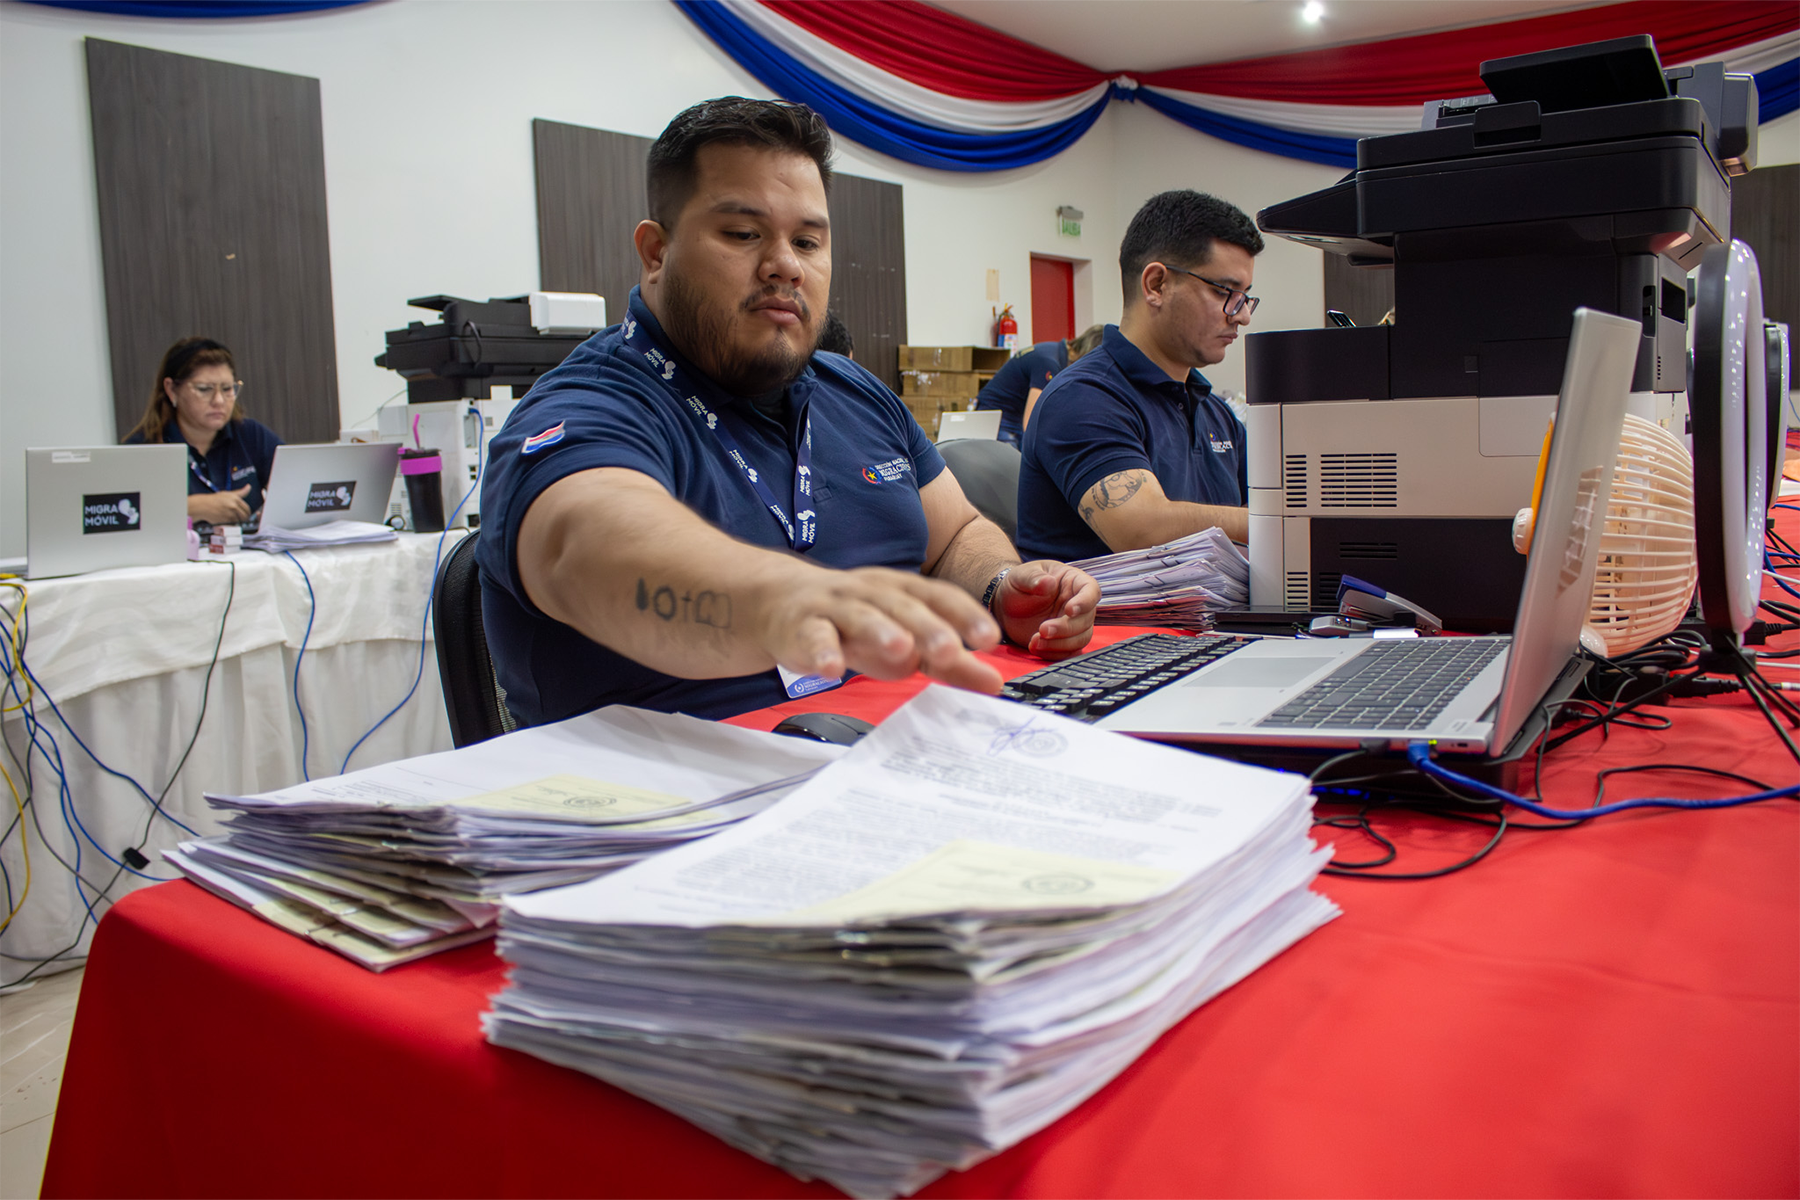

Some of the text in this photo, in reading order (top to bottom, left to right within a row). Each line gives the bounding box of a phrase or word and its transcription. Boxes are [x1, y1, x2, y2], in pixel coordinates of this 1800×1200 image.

[650, 348, 666, 364] MIGRA
[691, 395, 708, 415] MIGRA
[84, 504, 119, 515] MIGRA
[808, 522, 816, 544] MÓVIL
